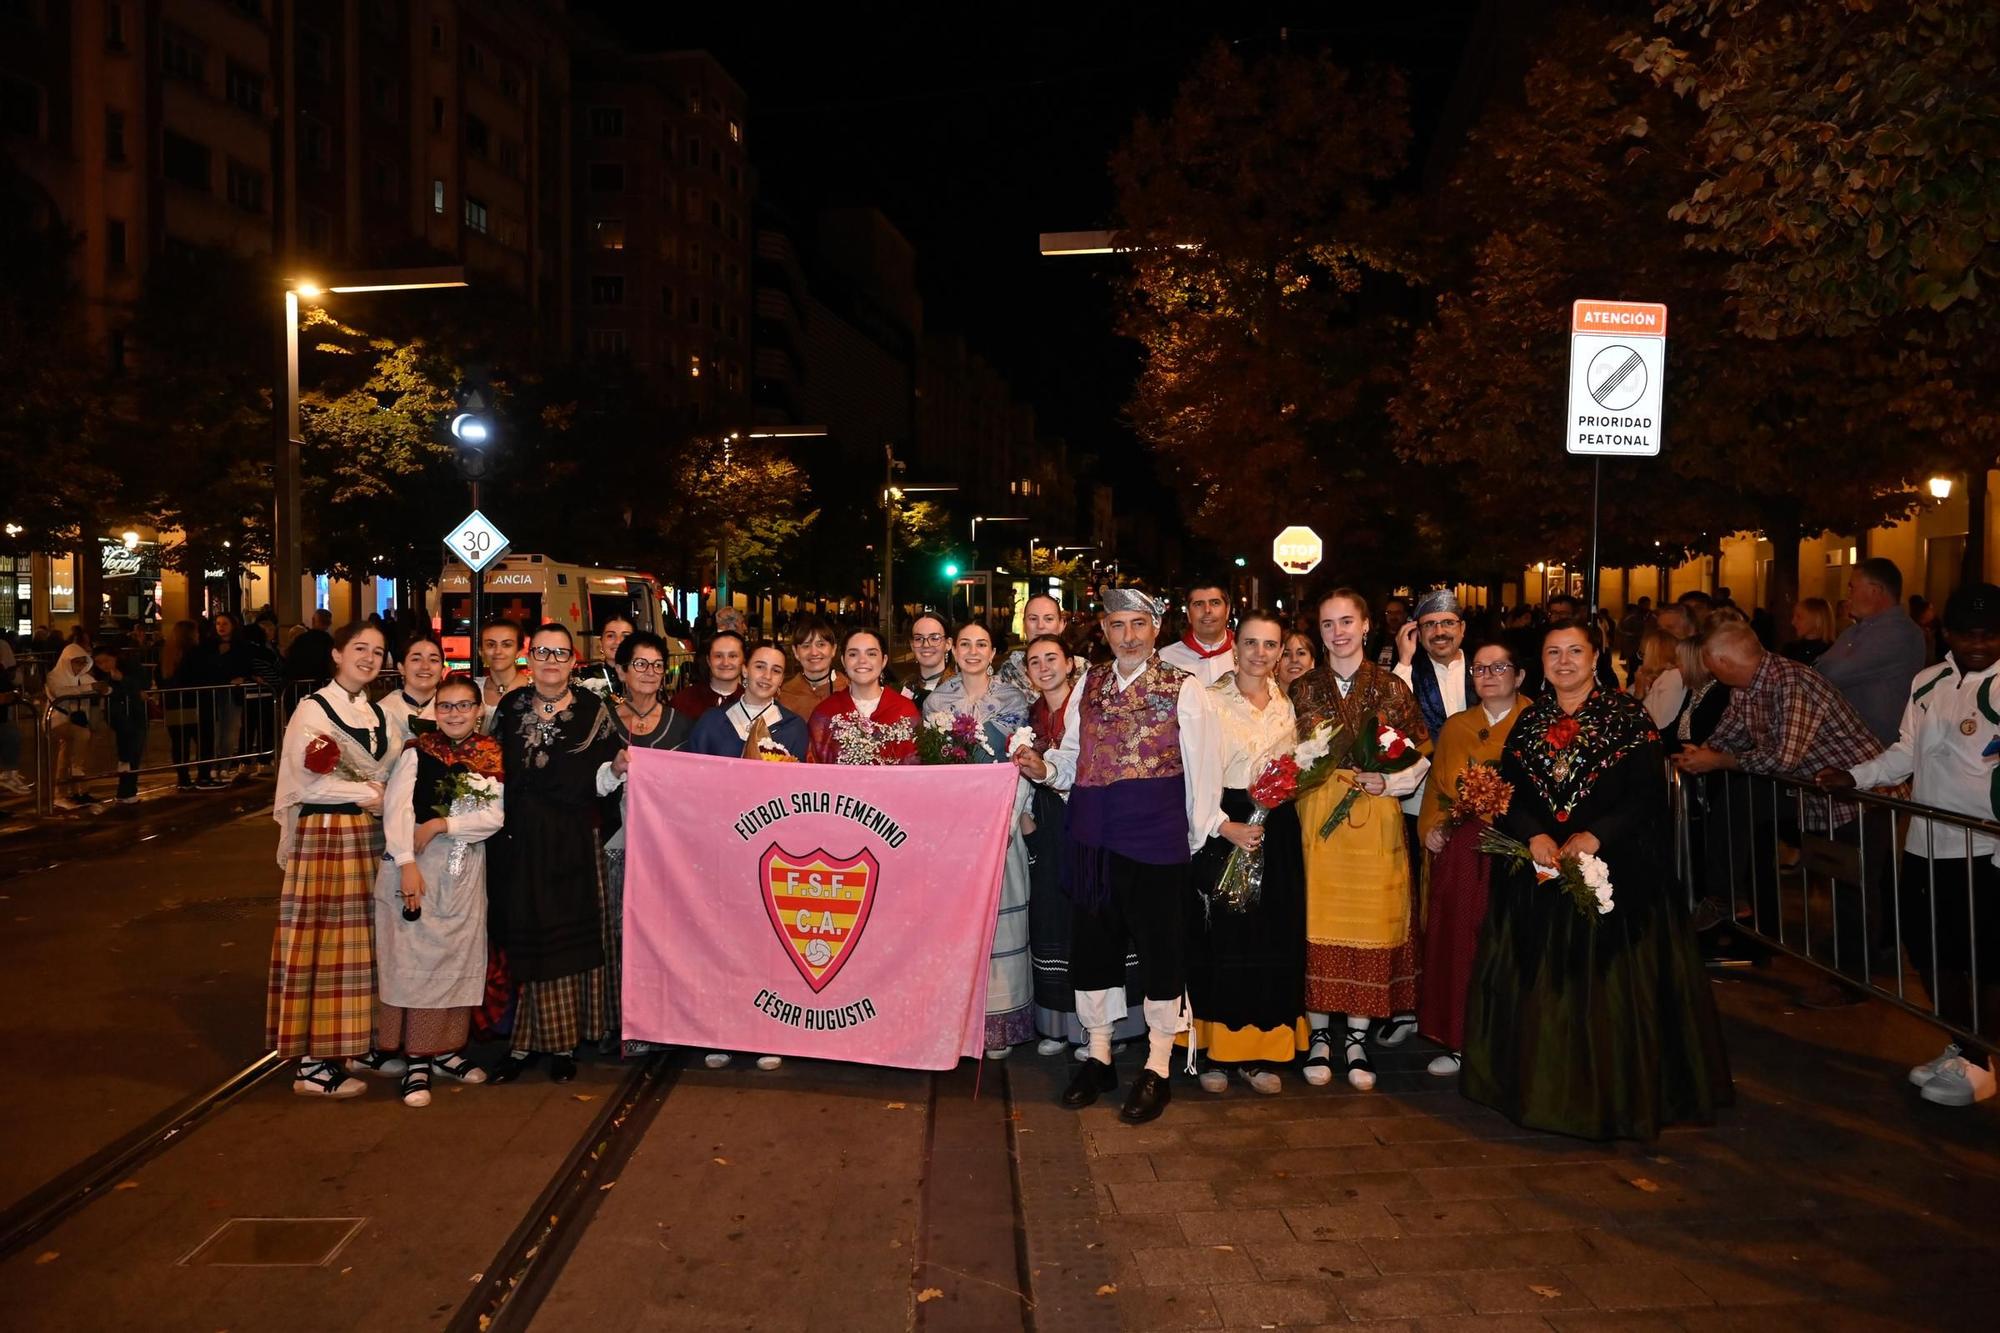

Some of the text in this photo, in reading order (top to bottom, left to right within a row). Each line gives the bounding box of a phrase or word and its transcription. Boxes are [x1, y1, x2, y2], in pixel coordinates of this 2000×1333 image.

[1584, 311, 1656, 325] ATENCIÓN
[1578, 416, 1652, 428] PRIORIDAD
[1579, 433, 1650, 446] PEATONAL
[462, 530, 491, 552] 30
[734, 792, 908, 849] FÚTBOL SALA FEMENINO
[787, 871, 852, 898] F.S.F.
[796, 909, 842, 935] C.A.
[753, 988, 876, 1031] CÉSAR AUGUSTA
